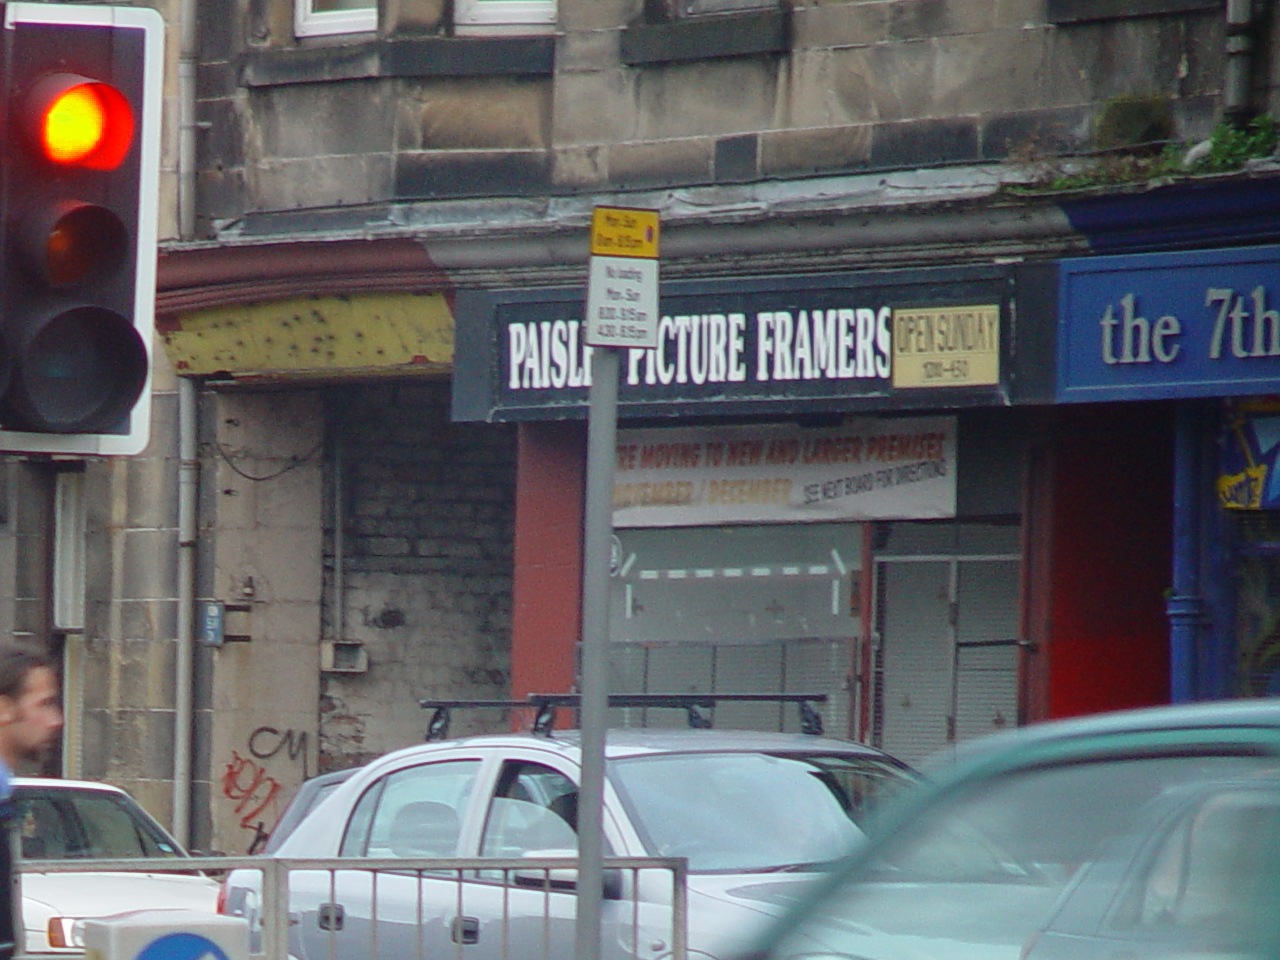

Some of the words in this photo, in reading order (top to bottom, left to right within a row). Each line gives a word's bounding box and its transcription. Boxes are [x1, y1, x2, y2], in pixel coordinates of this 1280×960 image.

[897, 314, 935, 353] OPEN
[937, 312, 996, 352] SUNDAY
[1100, 292, 1182, 365] the
[1204, 285, 1280, 360] 7th
[508, 319, 593, 389] PAISL
[756, 306, 892, 381] FRAMERS
[639, 443, 701, 469] MOVING
[704, 441, 722, 467] TO
[725, 440, 764, 467] NEW
[765, 438, 799, 465] AND
[800, 436, 862, 465] LARGER
[868, 432, 946, 463] PREMISES
[707, 478, 793, 506] DECEMBER
[804, 483, 821, 505] SEE
